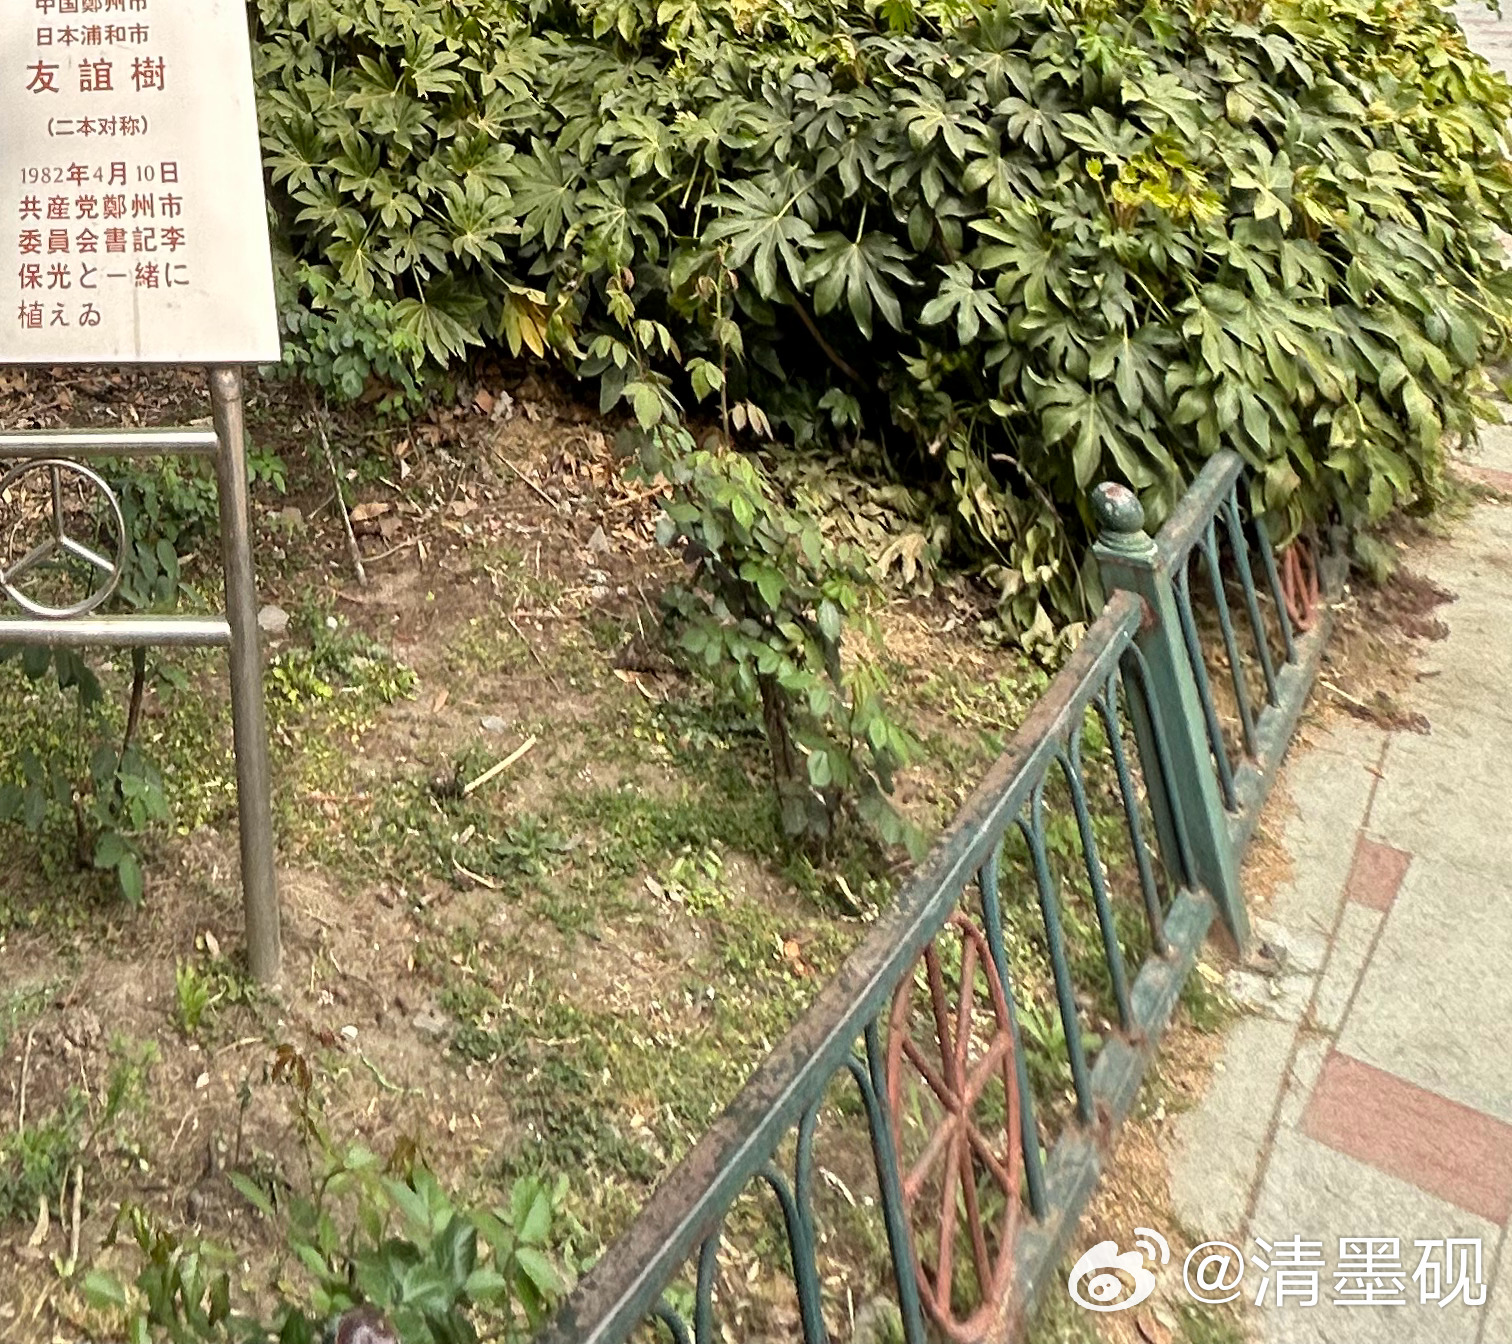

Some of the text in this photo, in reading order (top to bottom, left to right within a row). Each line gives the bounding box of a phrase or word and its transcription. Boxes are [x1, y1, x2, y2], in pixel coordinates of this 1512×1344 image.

[36, 23, 150, 47] 日本浦和市
[25, 56, 167, 94] 友誼樹
[47, 115, 148, 137] (二本对称)
[20, 161, 179, 187] 1982年4月10日
[18, 192, 184, 221] 共産党鄭州市
[18, 226, 186, 255] 委員会書記李
[18, 261, 190, 290] 保光と一緒に
